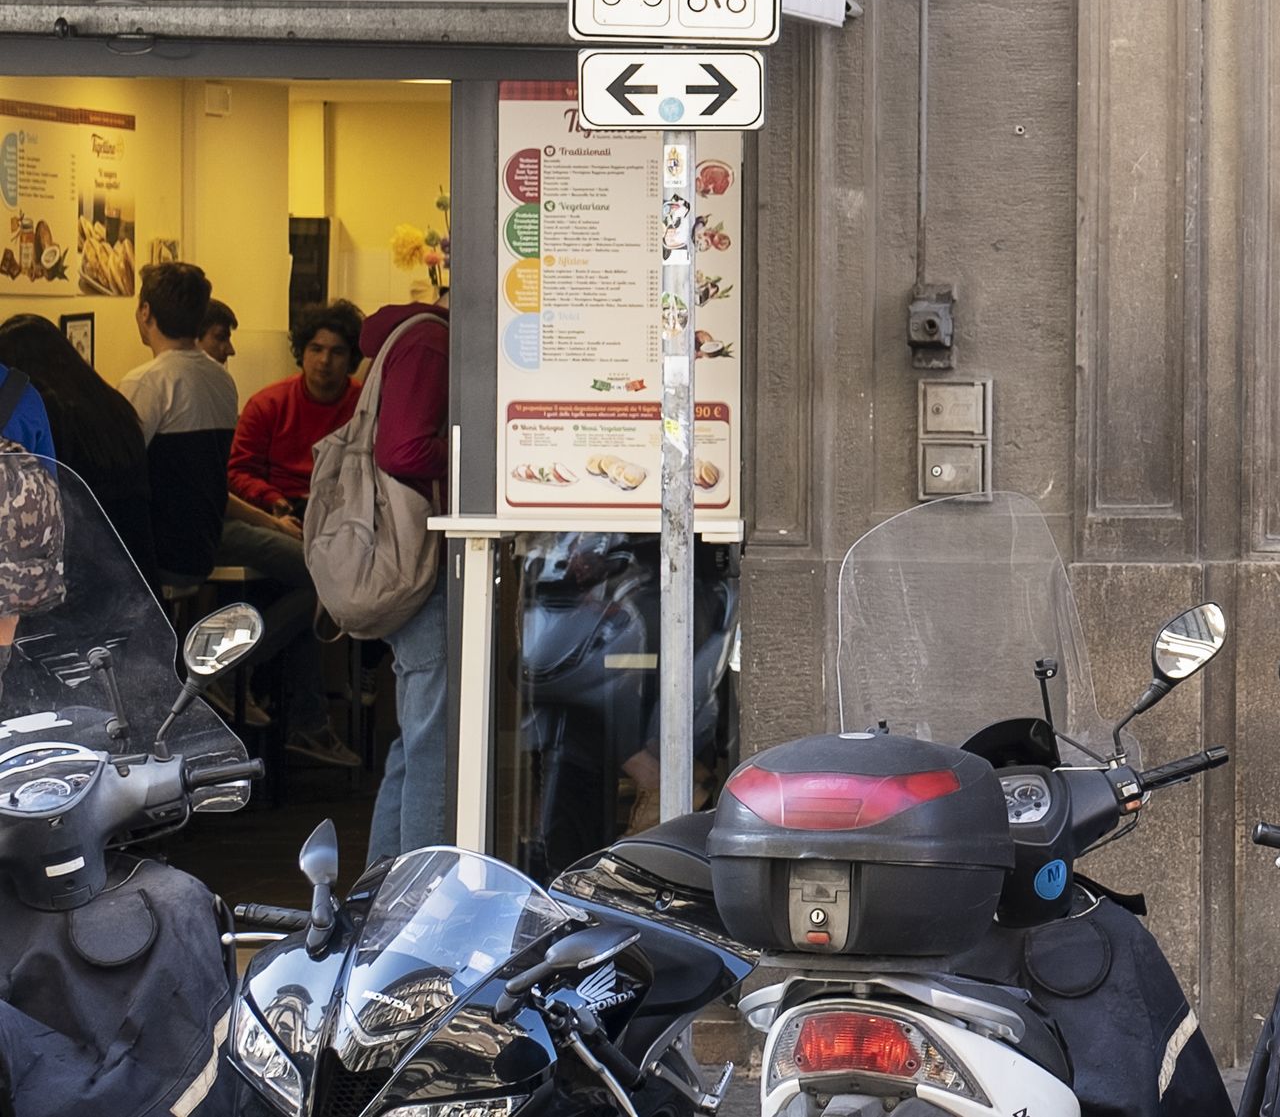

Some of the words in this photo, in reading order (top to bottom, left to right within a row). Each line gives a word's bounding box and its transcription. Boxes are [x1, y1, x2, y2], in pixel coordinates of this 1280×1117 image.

[558, 148, 611, 156] Tradizionali
[558, 202, 610, 213] Vegetariane
[695, 406, 711, 418] 90
[713, 406, 722, 418] €
[1047, 865, 1060, 883] M
[361, 989, 412, 1014] HONDA
